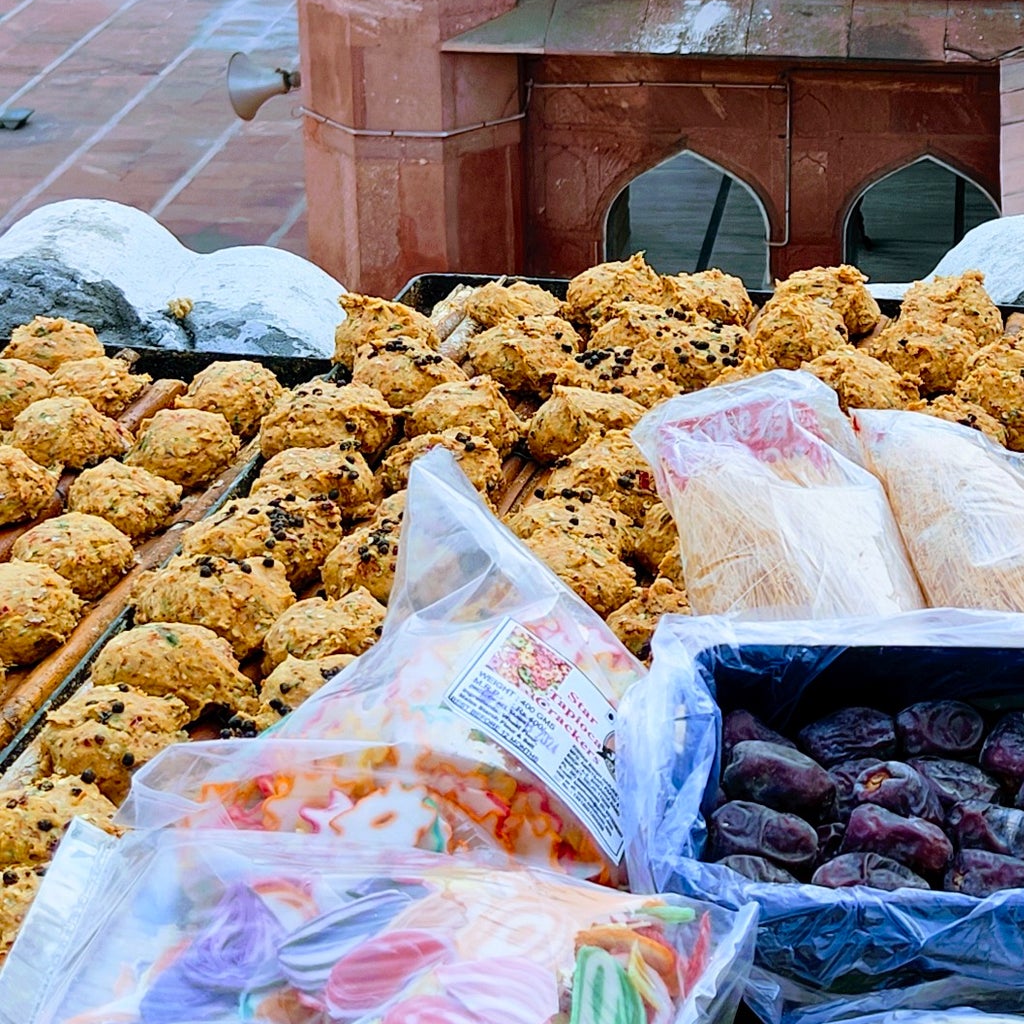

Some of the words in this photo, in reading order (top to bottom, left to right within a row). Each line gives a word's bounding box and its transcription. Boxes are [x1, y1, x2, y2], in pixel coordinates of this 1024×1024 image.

[478, 670, 514, 696] WEIGHT
[519, 699, 535, 713] 400
[535, 712, 556, 730] GMS
[533, 694, 600, 764] Crackers
[547, 689, 603, 749] Tapioca
[566, 690, 598, 726] Star
